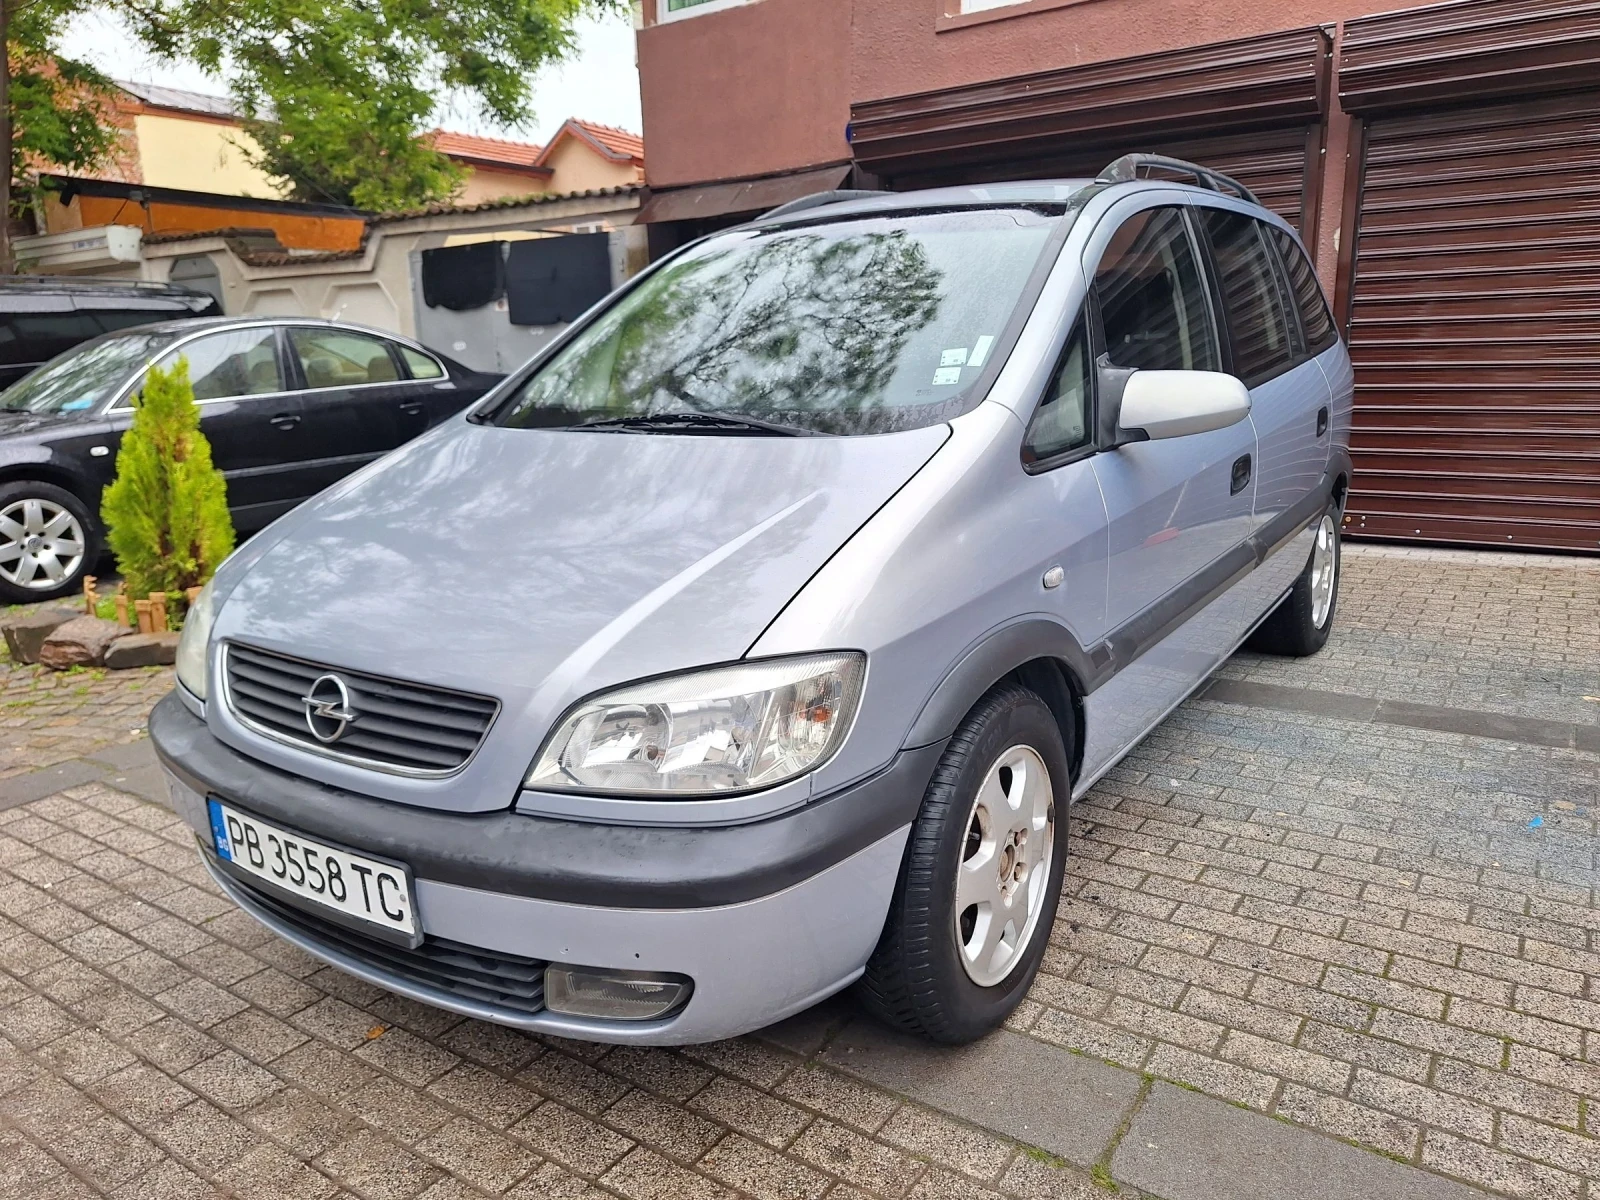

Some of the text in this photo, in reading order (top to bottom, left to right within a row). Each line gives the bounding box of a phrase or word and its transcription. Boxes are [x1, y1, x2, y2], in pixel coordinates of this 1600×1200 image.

[218, 836, 229, 851] BG
[227, 815, 404, 922] PB 3558 TC
